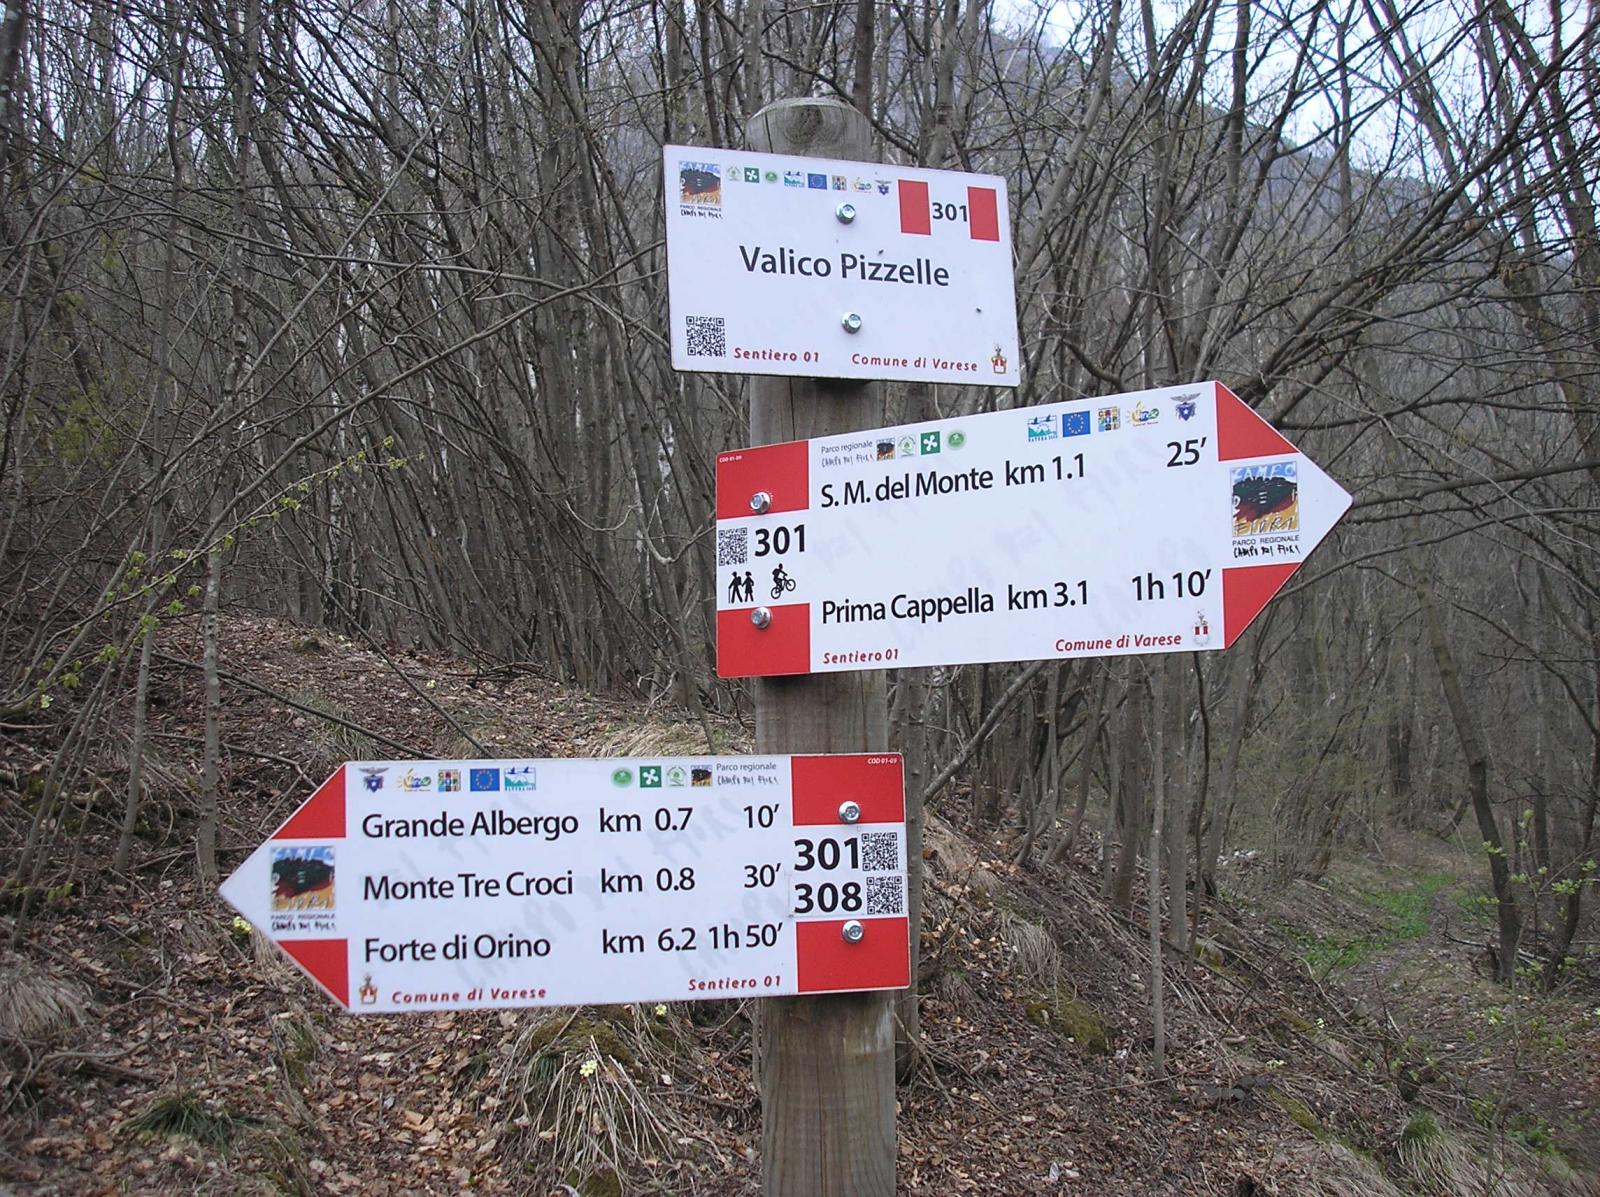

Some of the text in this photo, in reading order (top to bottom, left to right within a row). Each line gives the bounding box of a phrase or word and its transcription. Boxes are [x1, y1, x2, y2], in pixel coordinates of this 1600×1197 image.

[932, 202, 968, 222] 301
[739, 246, 949, 286] Valico Pizzelle
[734, 348, 819, 363] Sentiero 01
[852, 353, 977, 372] Comune di Varese
[841, 441, 872, 452] regionale
[821, 437, 1207, 508] S. M. del Monte km 1.1 25'
[755, 524, 805, 556] 301
[1233, 535, 1299, 546] PARCO REGIONALE
[823, 570, 1211, 624] Prima Cappella km 3.1 1h 10'
[1056, 634, 1181, 653] Comune di Varese
[823, 649, 899, 664] Sentiero 01
[716, 762, 777, 772] Parco regionale
[362, 804, 779, 841] Grande Albergo km 0.7 10'
[794, 837, 858, 872] 301
[364, 863, 781, 901] Monte Tre Croci km 0.8 30'
[795, 882, 863, 913] 308
[365, 923, 783, 963] Forte di Orino km 6.2 1h 50'
[689, 976, 782, 991] Sentiero 01
[392, 988, 547, 1004] Comune di Varese
